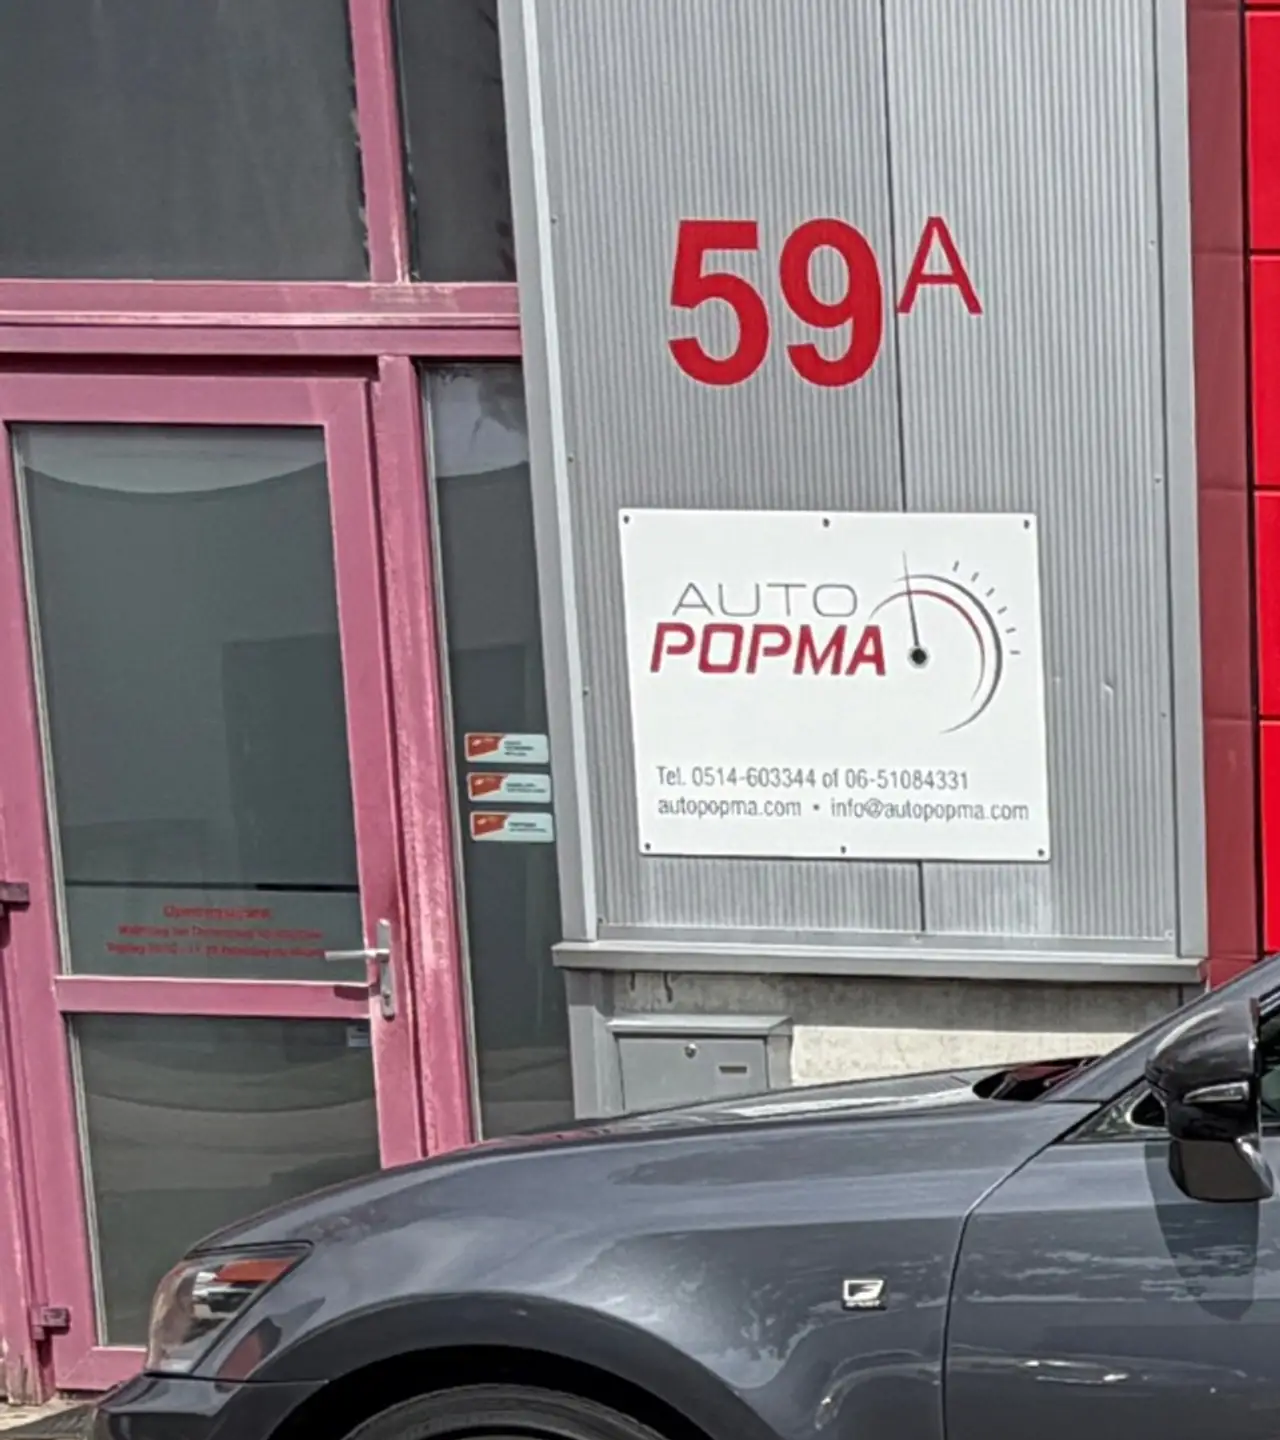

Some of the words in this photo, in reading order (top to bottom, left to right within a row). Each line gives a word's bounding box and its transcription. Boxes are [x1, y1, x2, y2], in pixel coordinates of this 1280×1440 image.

[672, 582, 858, 618] AUTO
[650, 622, 886, 676] POPMA
[656, 766, 687, 787] Tel.
[692, 766, 816, 788] 0514-603344
[822, 768, 840, 788] of
[845, 768, 969, 790] 06-51084331
[658, 796, 802, 820] autopopma.com
[831, 797, 1030, 822] info@autopopma.com
